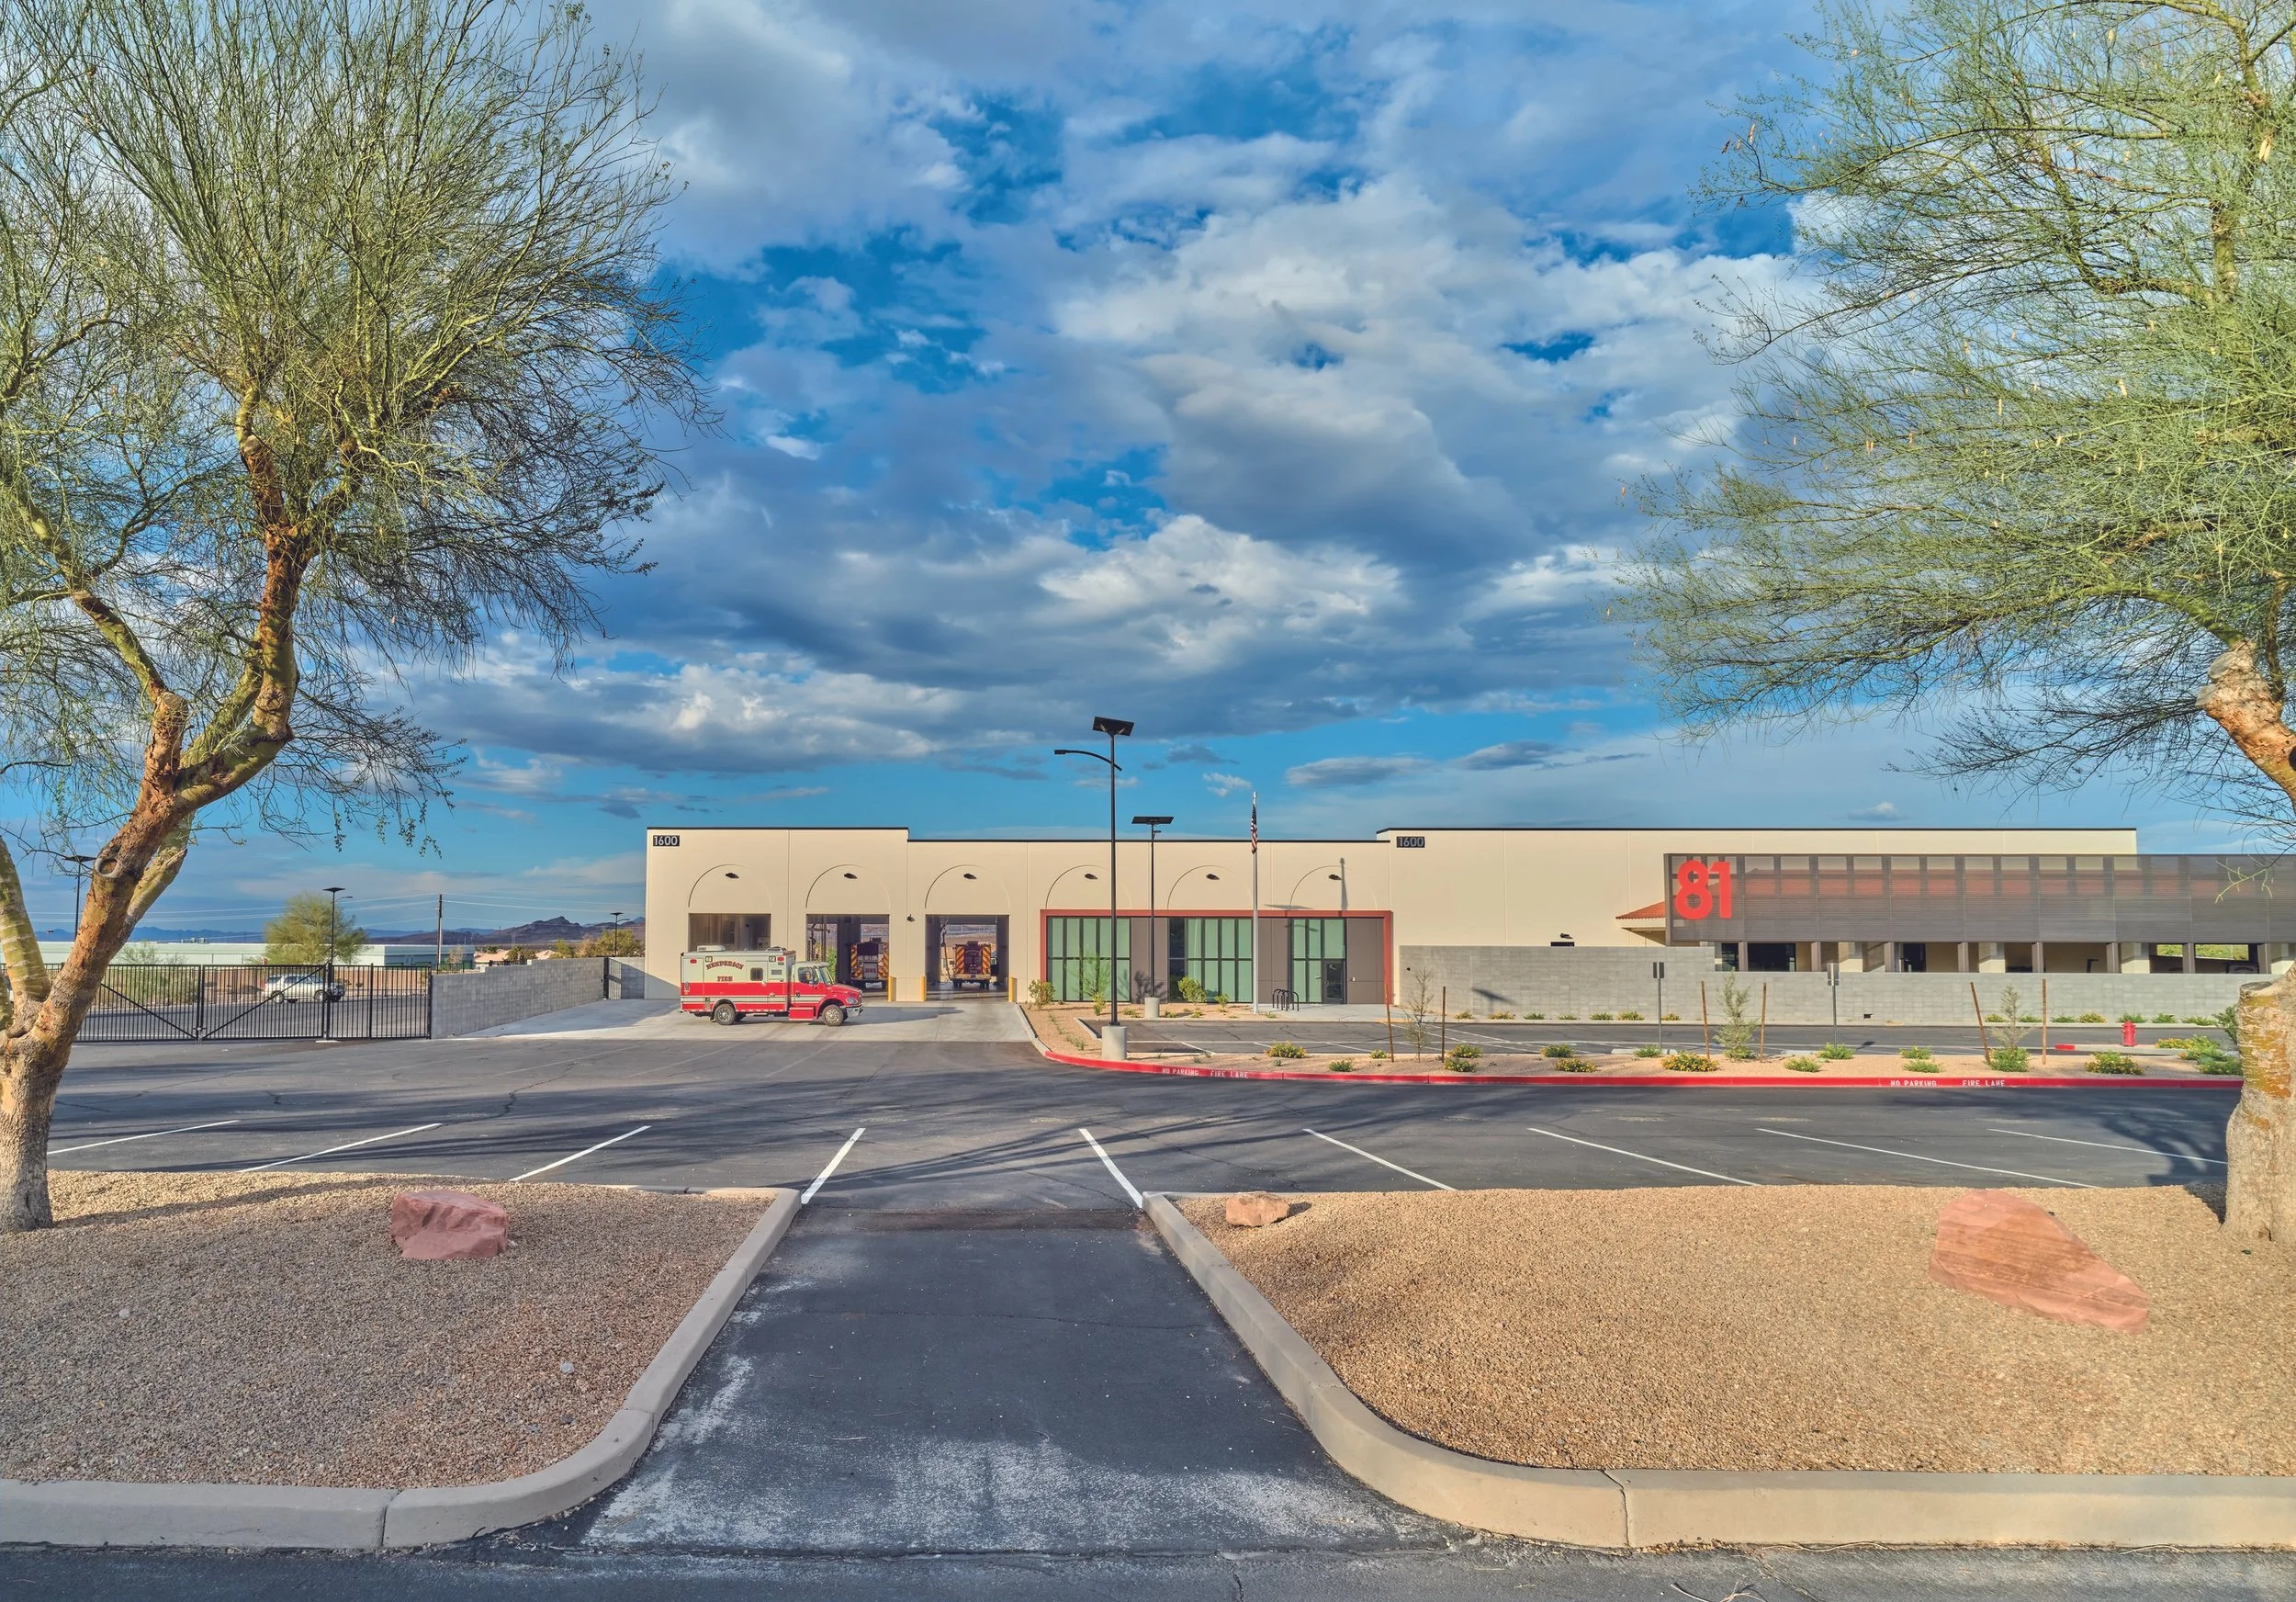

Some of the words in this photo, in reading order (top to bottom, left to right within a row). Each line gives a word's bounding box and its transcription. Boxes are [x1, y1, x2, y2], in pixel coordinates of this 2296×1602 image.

[653, 836, 679, 846] 1600
[1398, 837, 1424, 847] 1600
[1674, 859, 1732, 920] 81
[705, 960, 744, 970] HENDERSON
[1172, 1068, 1199, 1077] PARKING
[1904, 1079, 1937, 1088] PARKING
